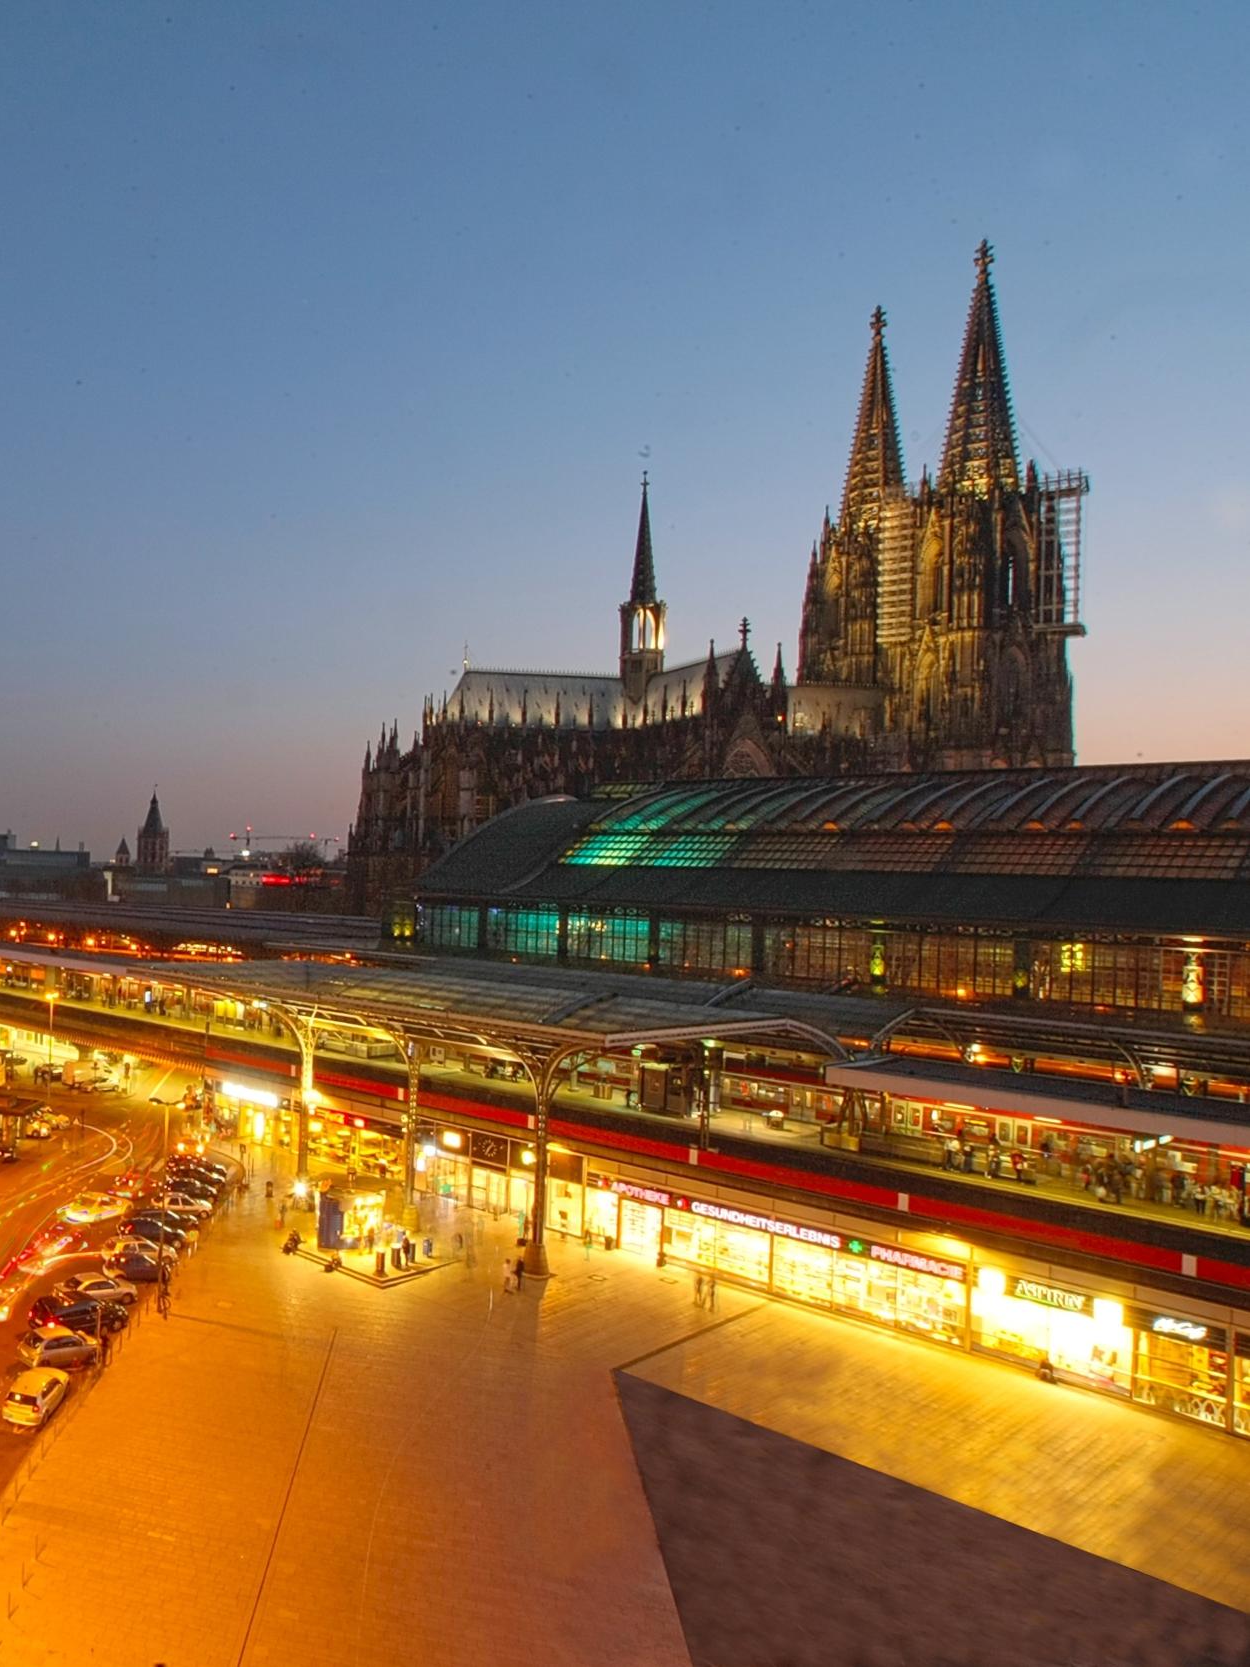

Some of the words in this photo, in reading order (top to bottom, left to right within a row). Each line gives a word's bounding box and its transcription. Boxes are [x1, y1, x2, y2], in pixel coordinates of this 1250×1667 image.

[611, 1181, 670, 1206] APOTHEKE
[691, 1201, 842, 1249] GESUNDHEITSERLEBNIS
[871, 1244, 963, 1281] PHARMACIE
[1014, 1279, 1086, 1311] ASPIRIN
